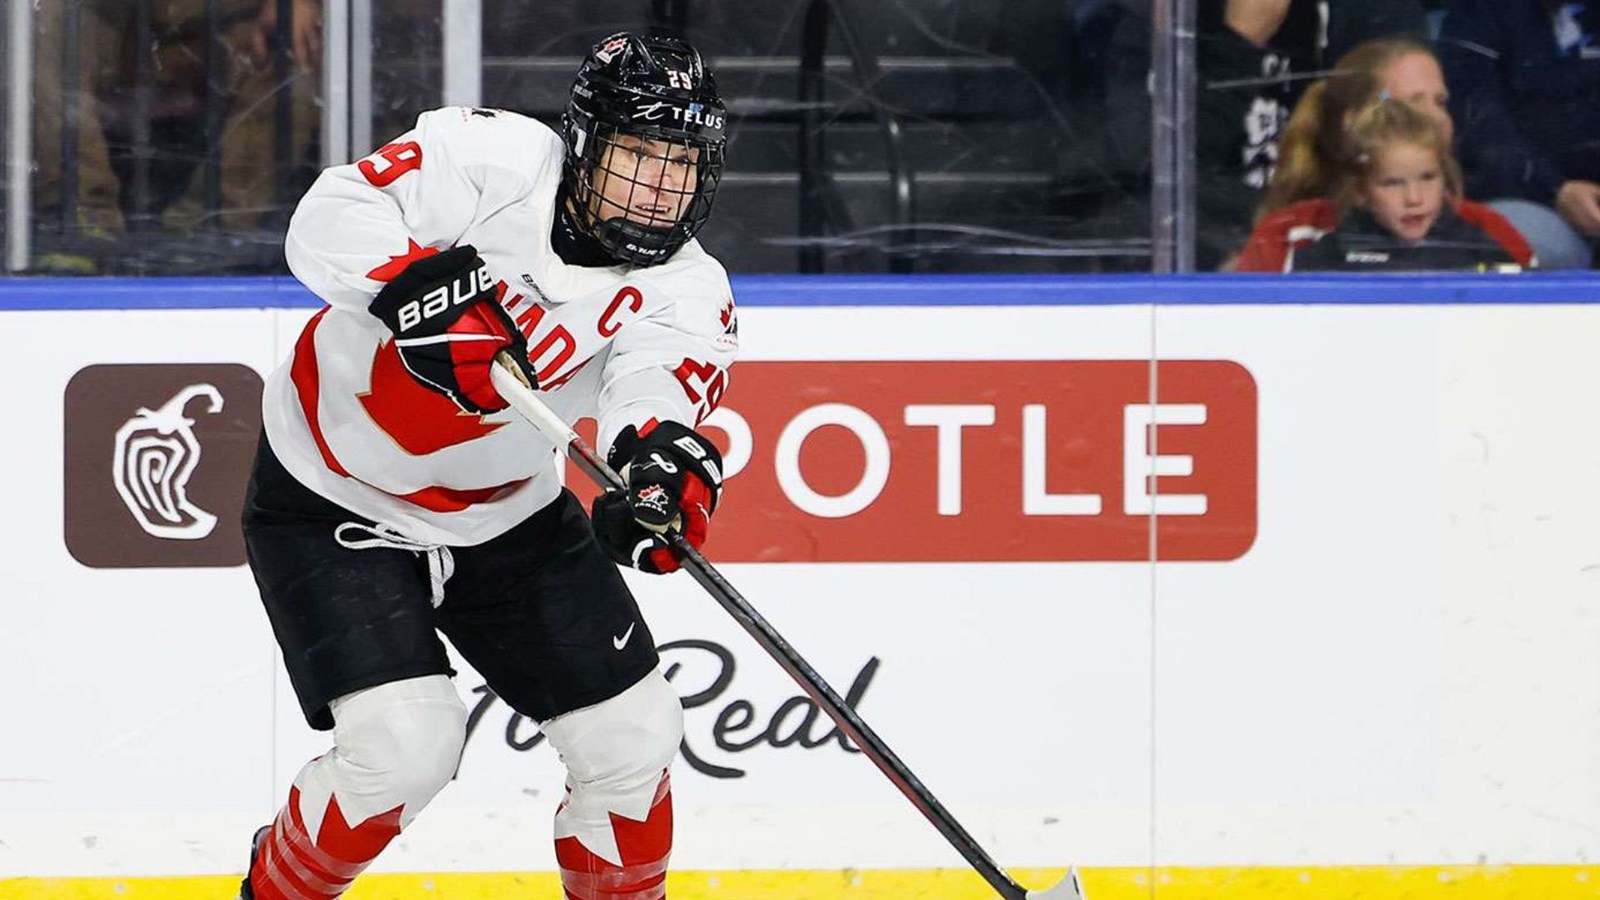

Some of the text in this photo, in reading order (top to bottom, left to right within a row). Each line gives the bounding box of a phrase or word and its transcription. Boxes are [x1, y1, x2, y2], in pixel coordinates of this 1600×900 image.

[667, 70, 693, 91] 29
[672, 107, 723, 130] TELUS
[358, 141, 423, 188] 9
[597, 285, 644, 338] C
